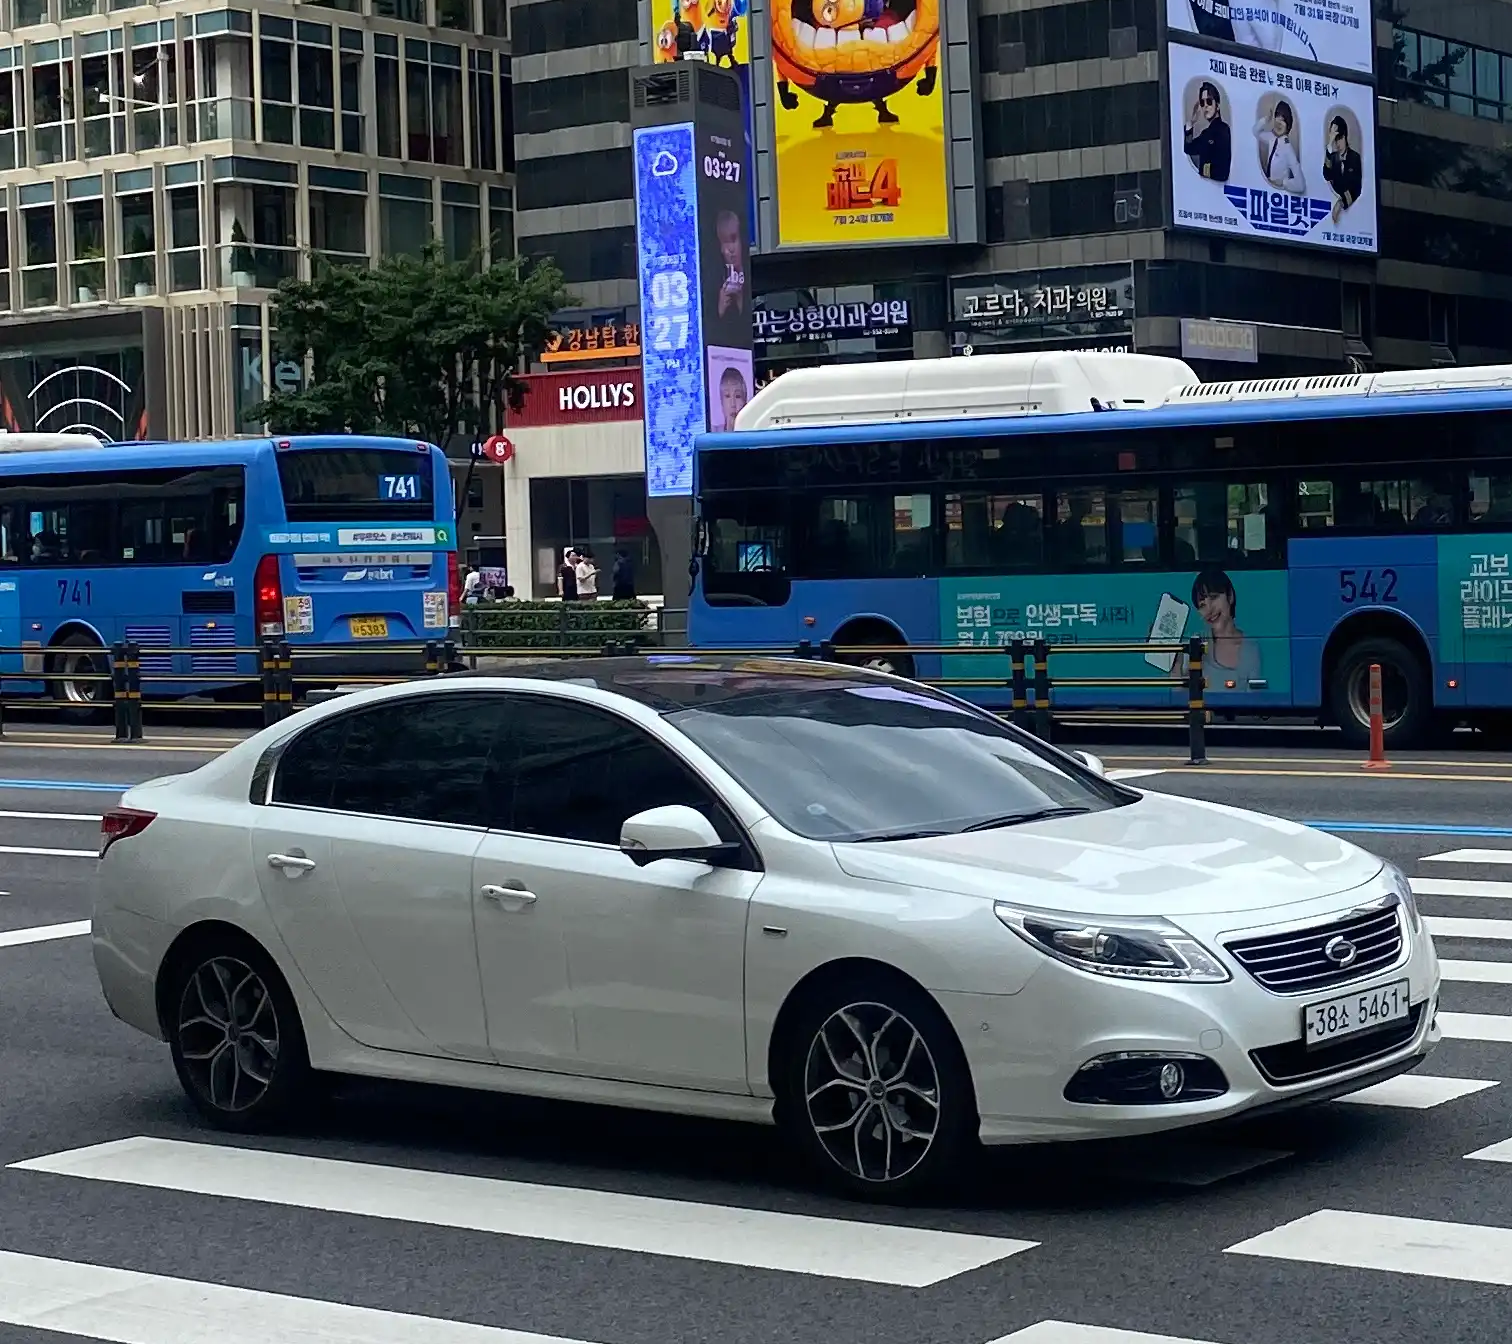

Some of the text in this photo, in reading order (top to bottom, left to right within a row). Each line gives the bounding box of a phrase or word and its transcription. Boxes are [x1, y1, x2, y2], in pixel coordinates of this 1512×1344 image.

[703, 156, 741, 182] 03:27
[871, 157, 902, 208] 4
[1249, 188, 1309, 229] 파일럿
[652, 271, 690, 309] 03
[653, 312, 690, 351] 27
[559, 382, 635, 410] HOLLYS
[384, 476, 416, 498] 741
[1469, 553, 1509, 577] 교보
[57, 579, 91, 606] 741
[1339, 568, 1399, 604] 542
[1025, 603, 1098, 627] 인생구독
[1315, 989, 1400, 1037] 38소 5461
